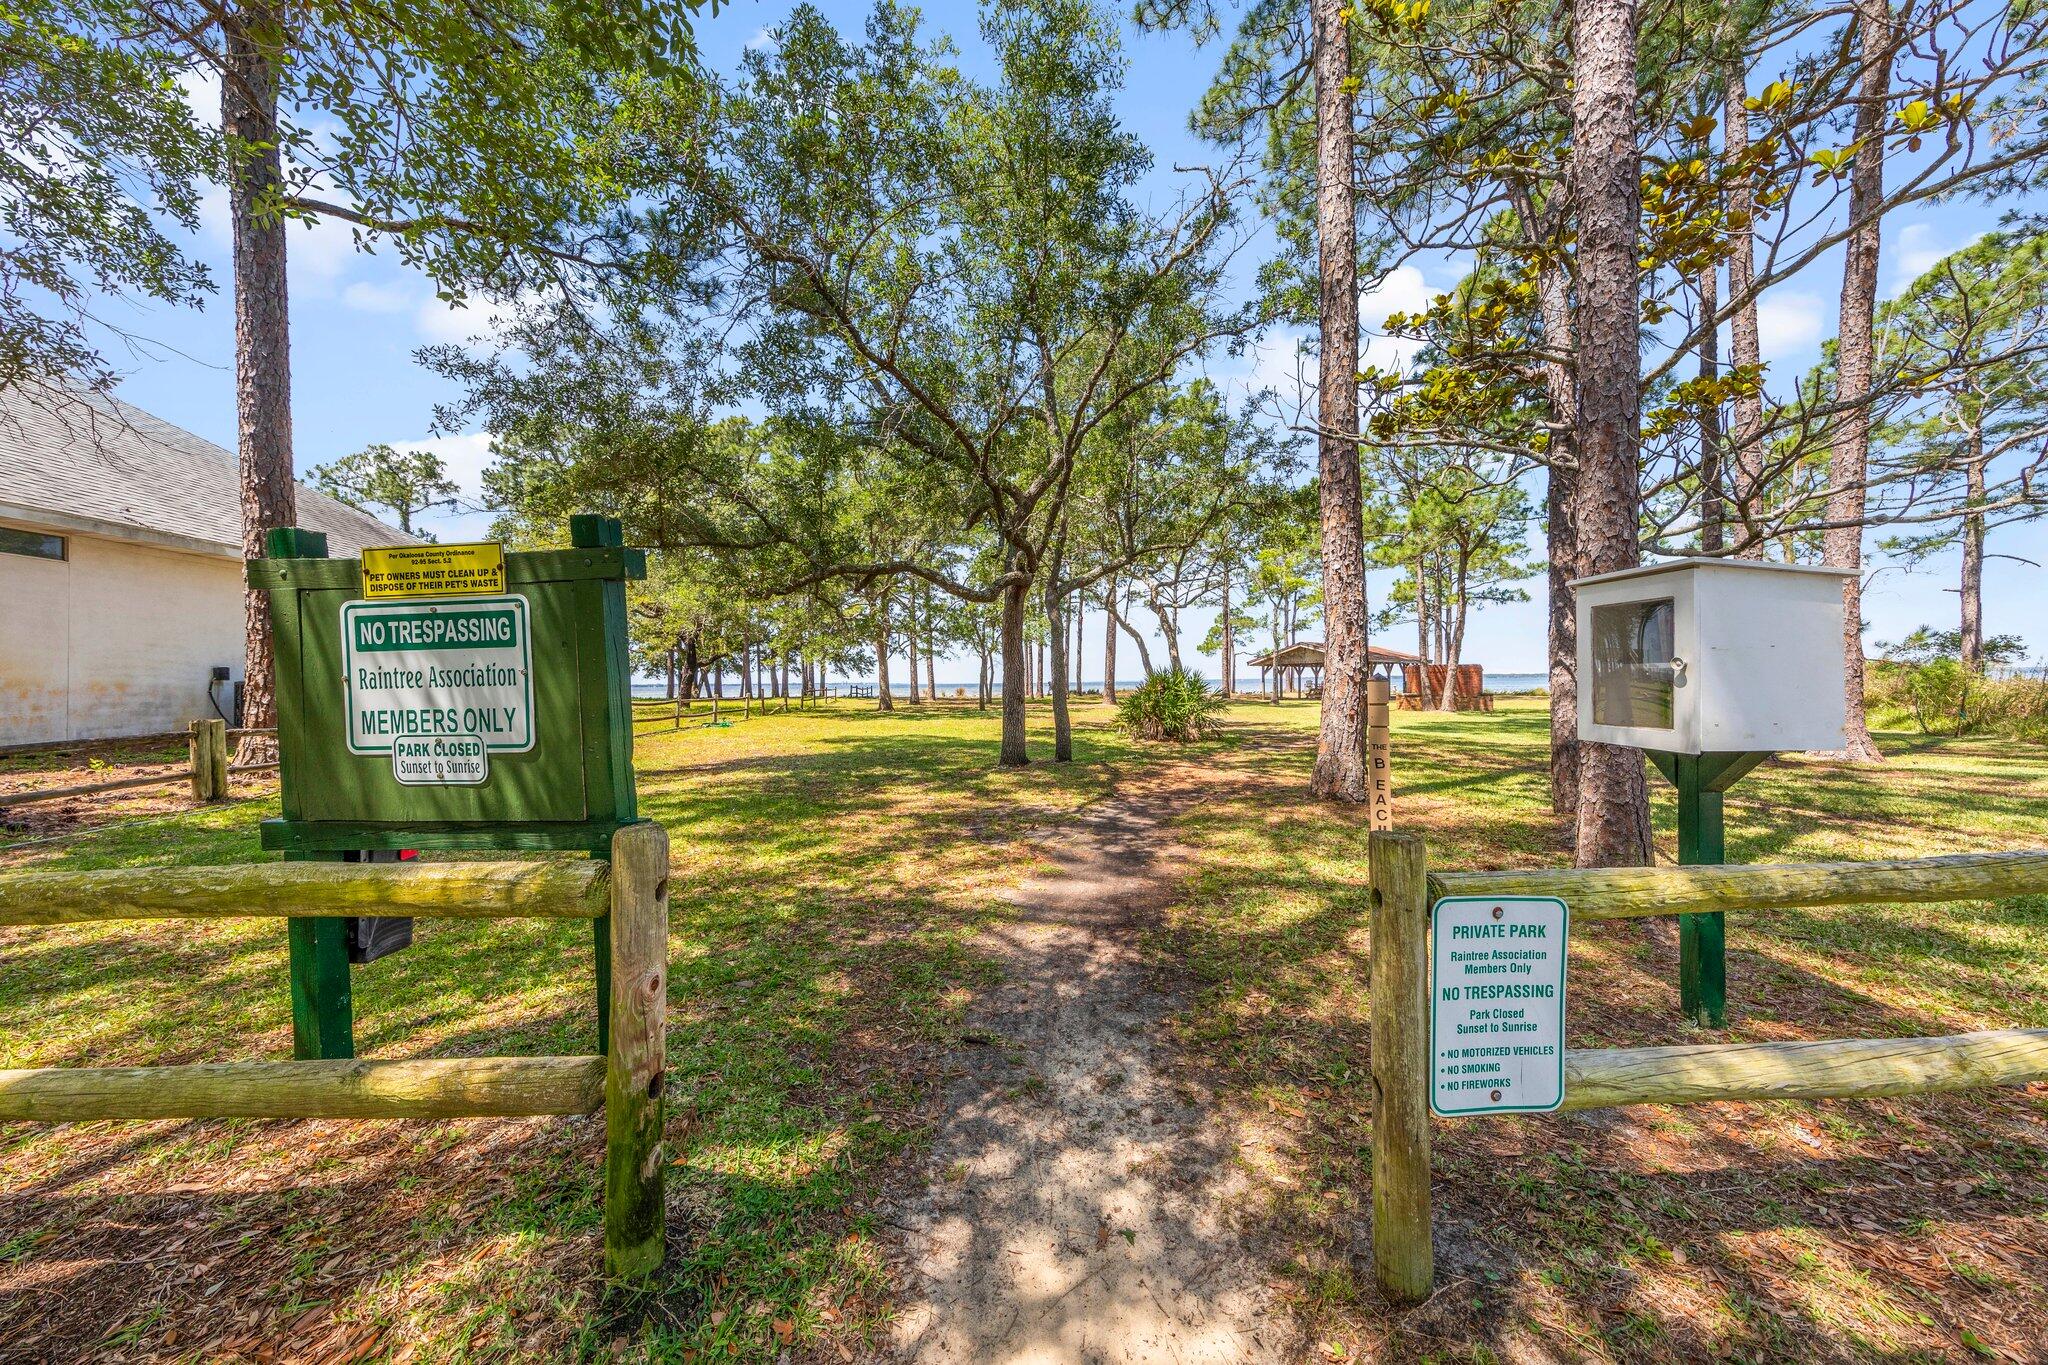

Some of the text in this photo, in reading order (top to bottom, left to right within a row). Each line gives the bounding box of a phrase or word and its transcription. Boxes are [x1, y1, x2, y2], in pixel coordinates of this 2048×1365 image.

[370, 573, 384, 581] PET
[386, 572, 421, 580] OWNERS
[422, 570, 445, 579] MUST
[447, 569, 475, 578] CLEAN
[491, 568, 498, 576] &
[370, 579, 498, 592] DISPOSE OF THEIR PET'S WASTE
[361, 617, 511, 645] NO TRESPASSING
[358, 662, 516, 690] Raintree Association
[362, 707, 516, 734] MEMBERS ONLY
[398, 742, 480, 756] PARK CLOSED
[400, 759, 480, 774] Sunset to Sunrise
[1452, 925, 1546, 939] PRIVATE PARK
[1450, 949, 1547, 962] Raintree Association
[1464, 963, 1532, 975] Members Only
[1442, 984, 1554, 1001] NO TRESPASSING
[1470, 1009, 1524, 1019] Park Closed
[1457, 1023, 1538, 1034] Sunset to Sunrise
[1447, 1046, 1554, 1059] NO MOTORIZED VEHICLES
[1447, 1063, 1501, 1074] NO SMOKING
[1447, 1079, 1511, 1091] NO FIREWORKS
